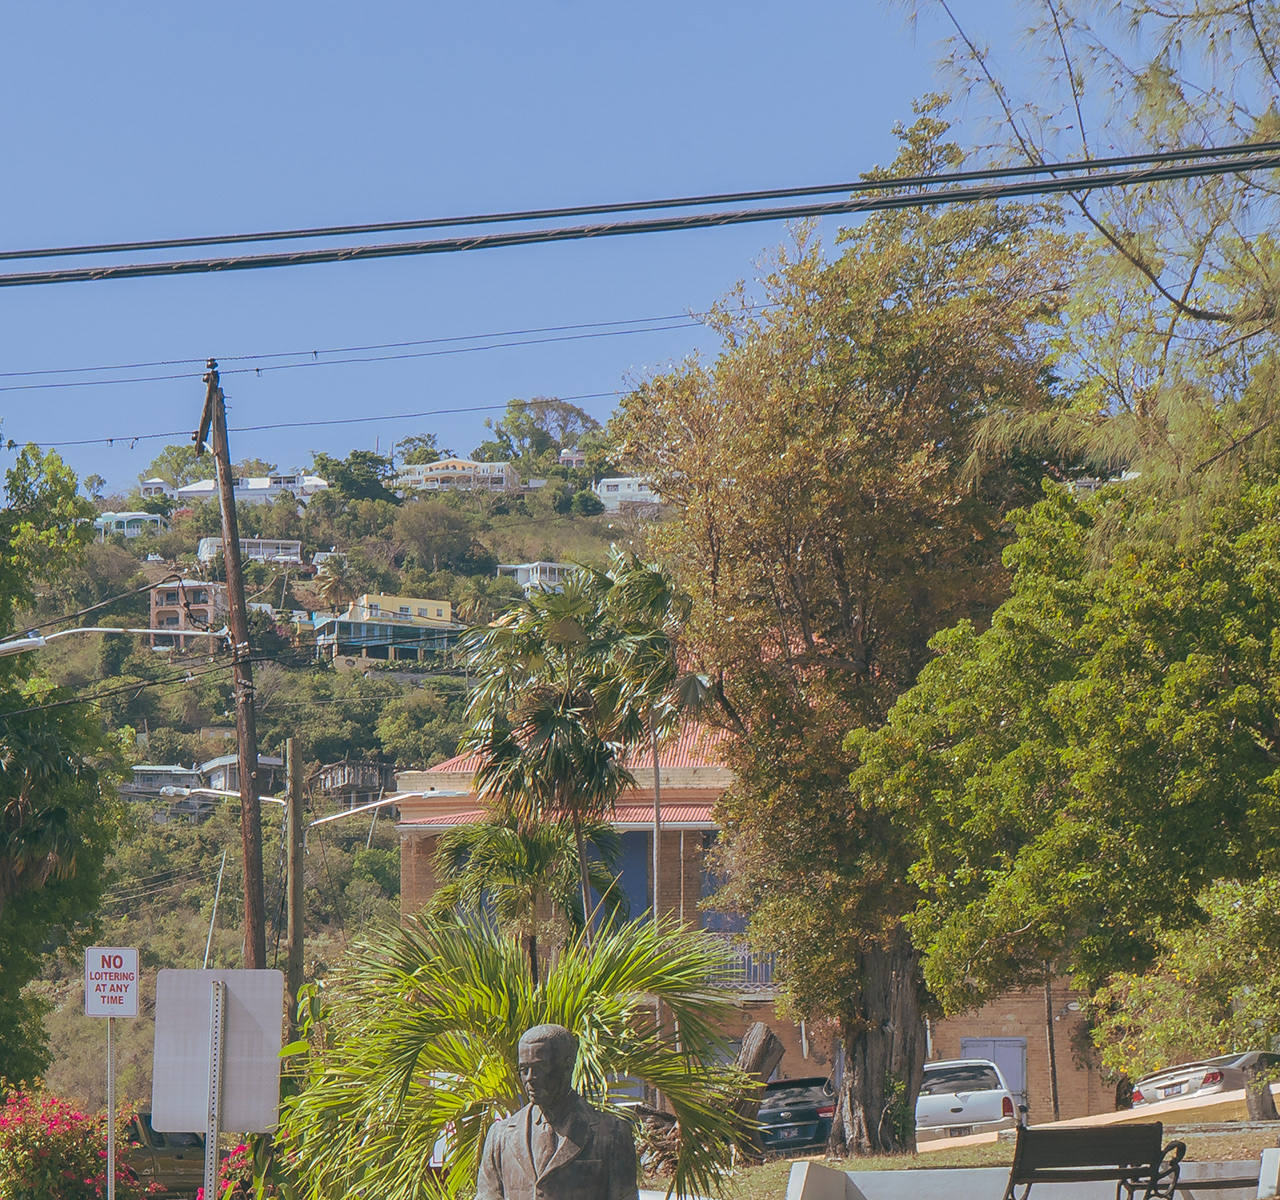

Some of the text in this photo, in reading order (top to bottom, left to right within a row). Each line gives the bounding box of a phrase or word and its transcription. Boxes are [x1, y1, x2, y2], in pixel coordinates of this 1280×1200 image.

[101, 954, 123, 969] NO
[89, 972, 135, 982] LOITERING
[94, 984, 130, 993] AT ANY
[100, 995, 124, 1005] TIME
